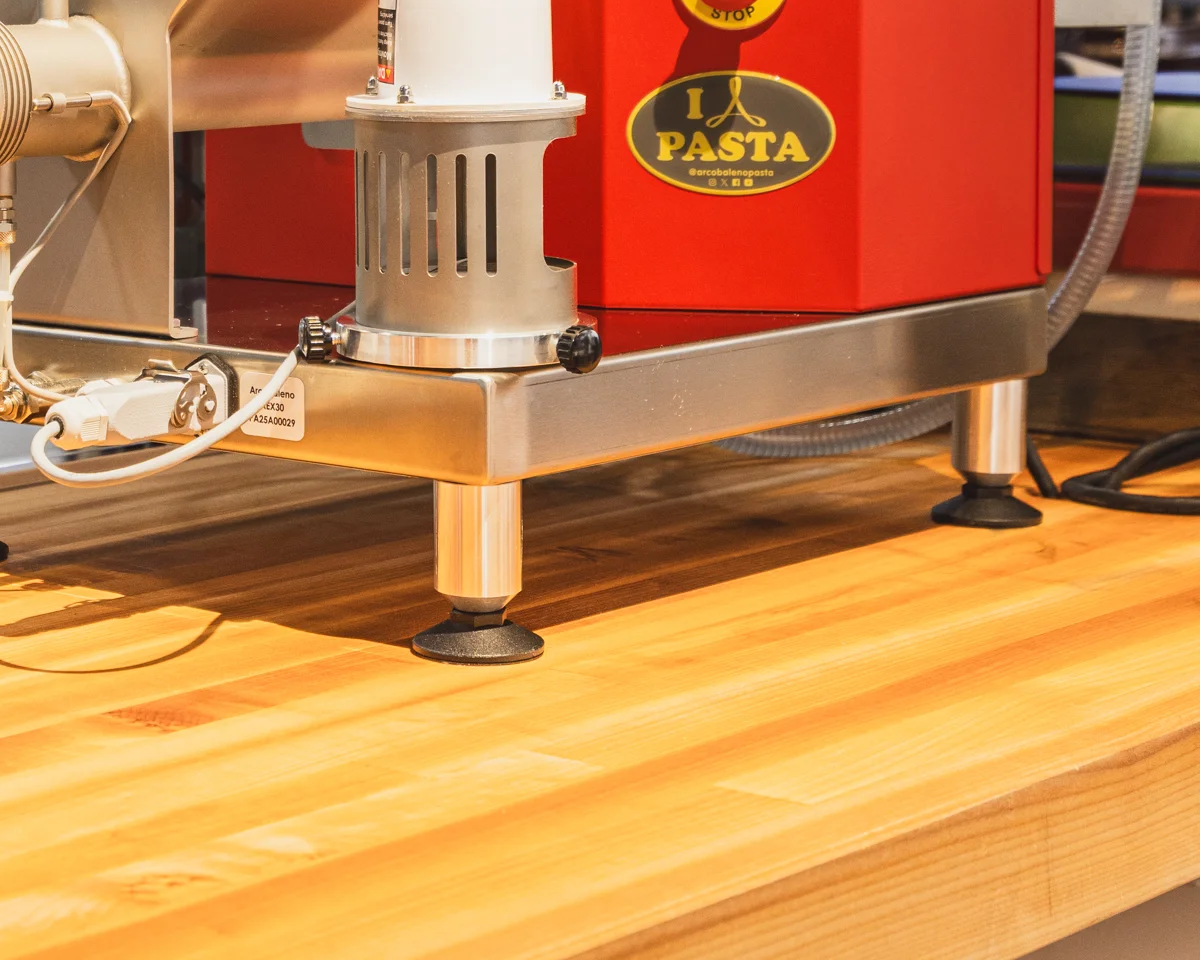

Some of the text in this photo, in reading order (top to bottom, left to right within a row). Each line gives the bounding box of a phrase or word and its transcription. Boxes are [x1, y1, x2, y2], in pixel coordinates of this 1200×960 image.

[711, 5, 755, 22] STOP
[686, 87, 704, 120] I
[656, 131, 810, 162] PASTA
[688, 167, 774, 178] @arcobalenopasta
[249, 414, 296, 427] A25A00029
